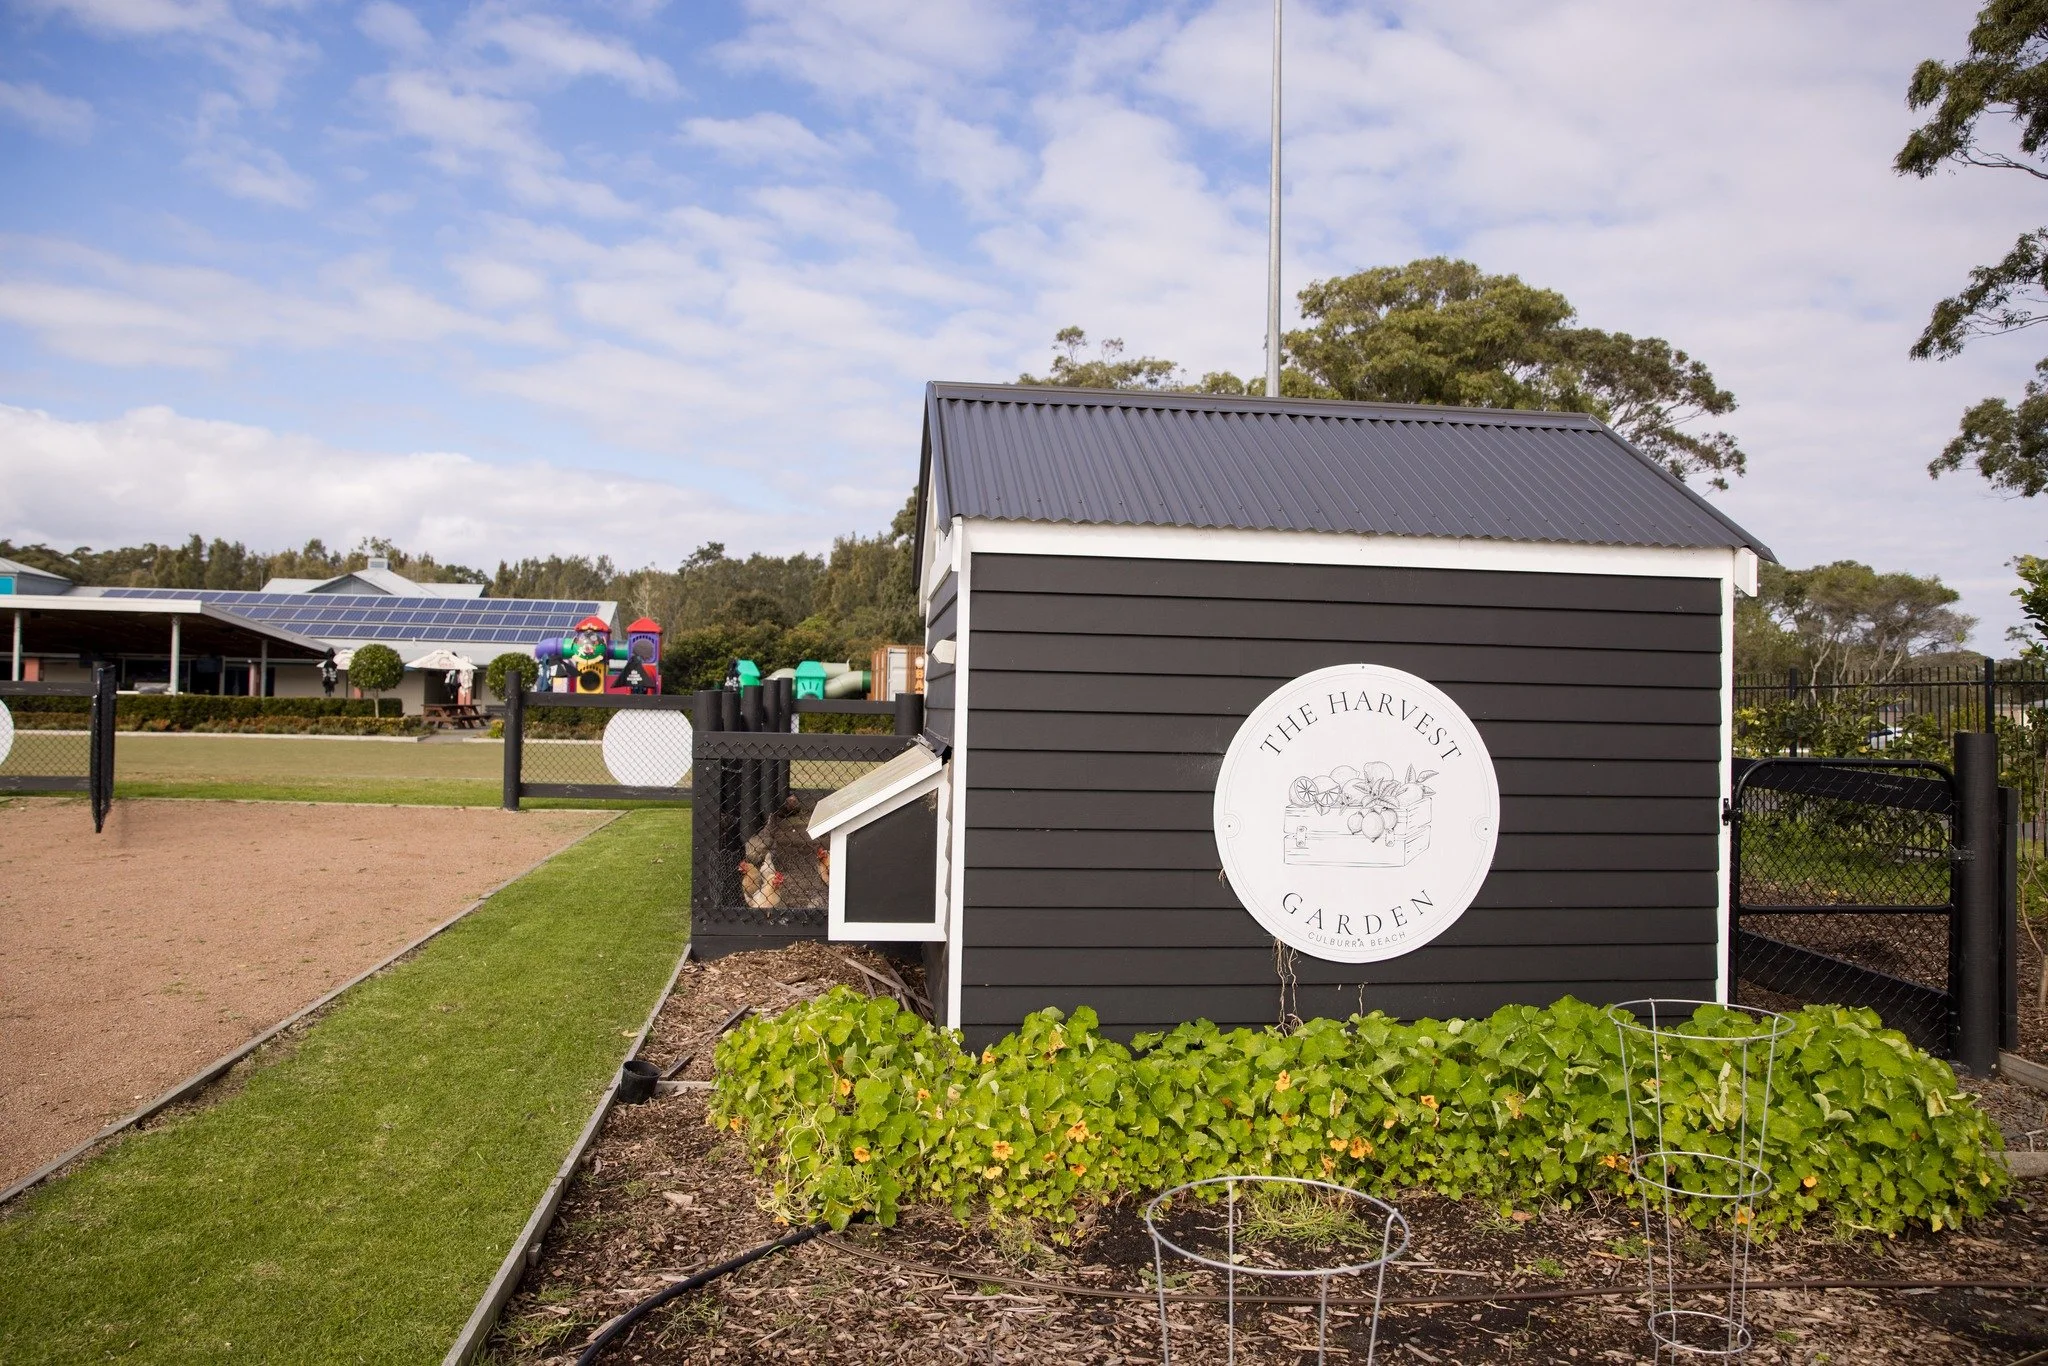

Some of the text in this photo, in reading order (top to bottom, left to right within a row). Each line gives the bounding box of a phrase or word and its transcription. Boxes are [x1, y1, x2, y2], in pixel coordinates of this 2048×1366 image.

[1260, 691, 1462, 760] THE HARVEST
[1282, 889, 1434, 936] GARDEN
[1308, 931, 1406, 948] CULBURRA BEACH
